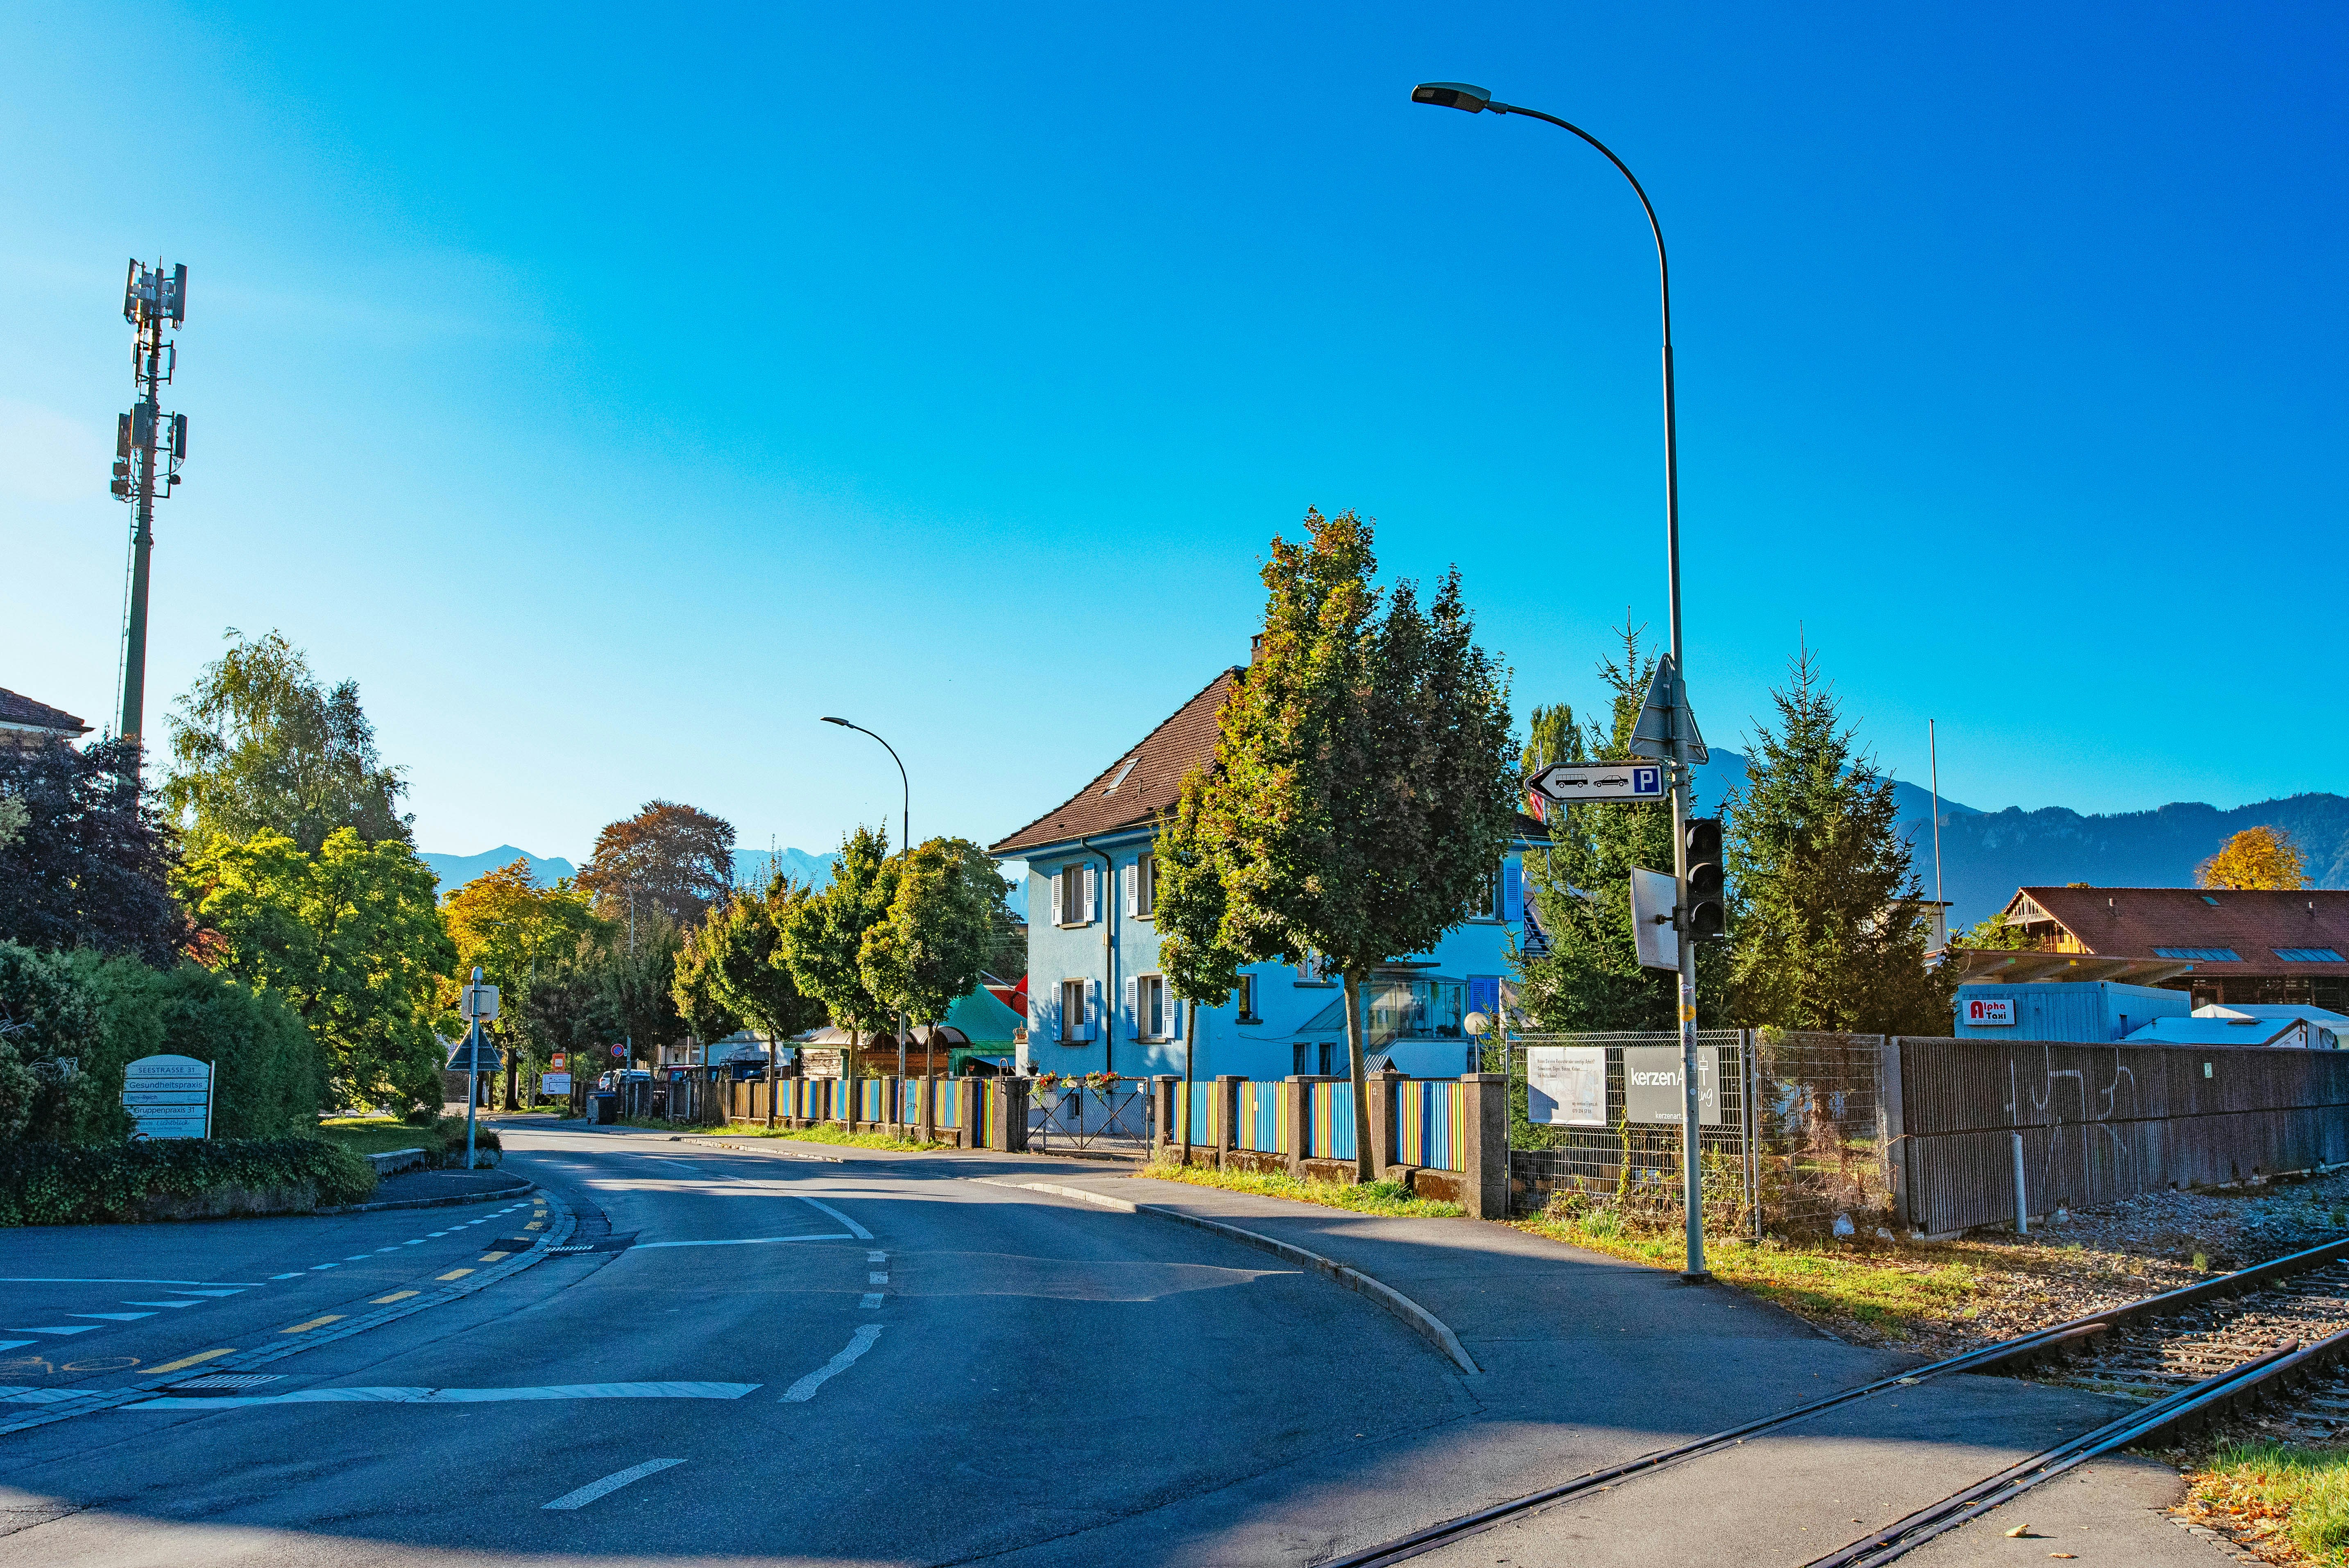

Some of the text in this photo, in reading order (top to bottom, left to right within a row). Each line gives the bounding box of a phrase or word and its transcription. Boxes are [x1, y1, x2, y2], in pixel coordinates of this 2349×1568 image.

[1640, 770, 1654, 791] P
[1970, 1001, 2005, 1019] Alpha
[1631, 1067, 1709, 1086] kerzenAT
[1697, 1087, 1713, 1107] ing
[1655, 1110, 1683, 1119] kerzenart.
